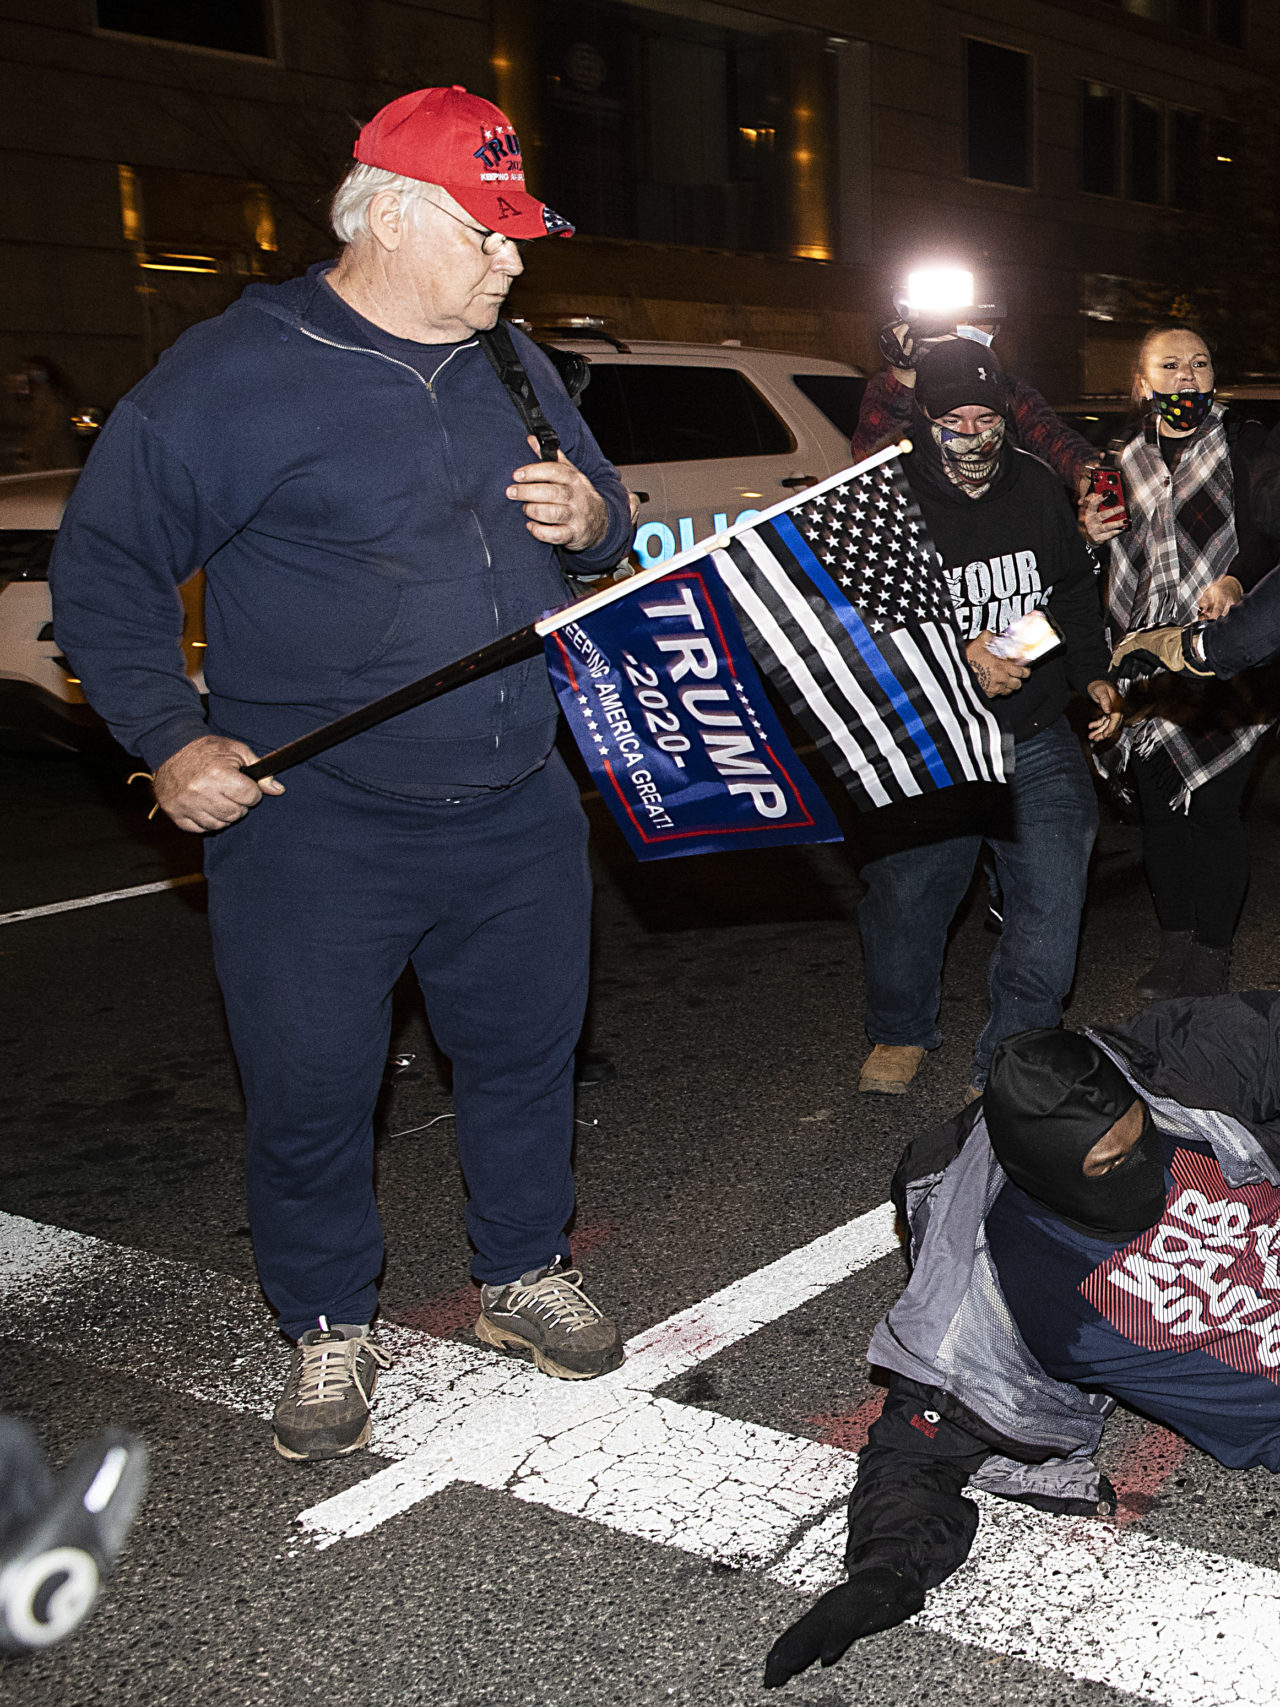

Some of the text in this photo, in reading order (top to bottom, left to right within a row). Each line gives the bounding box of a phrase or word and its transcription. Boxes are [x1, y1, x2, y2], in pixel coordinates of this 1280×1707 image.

[474, 134, 521, 168] TRU
[942, 550, 1042, 609] YOUR
[562, 622, 675, 829] EEPING AMERICA GREAT!
[644, 588, 788, 819] TRUMP
